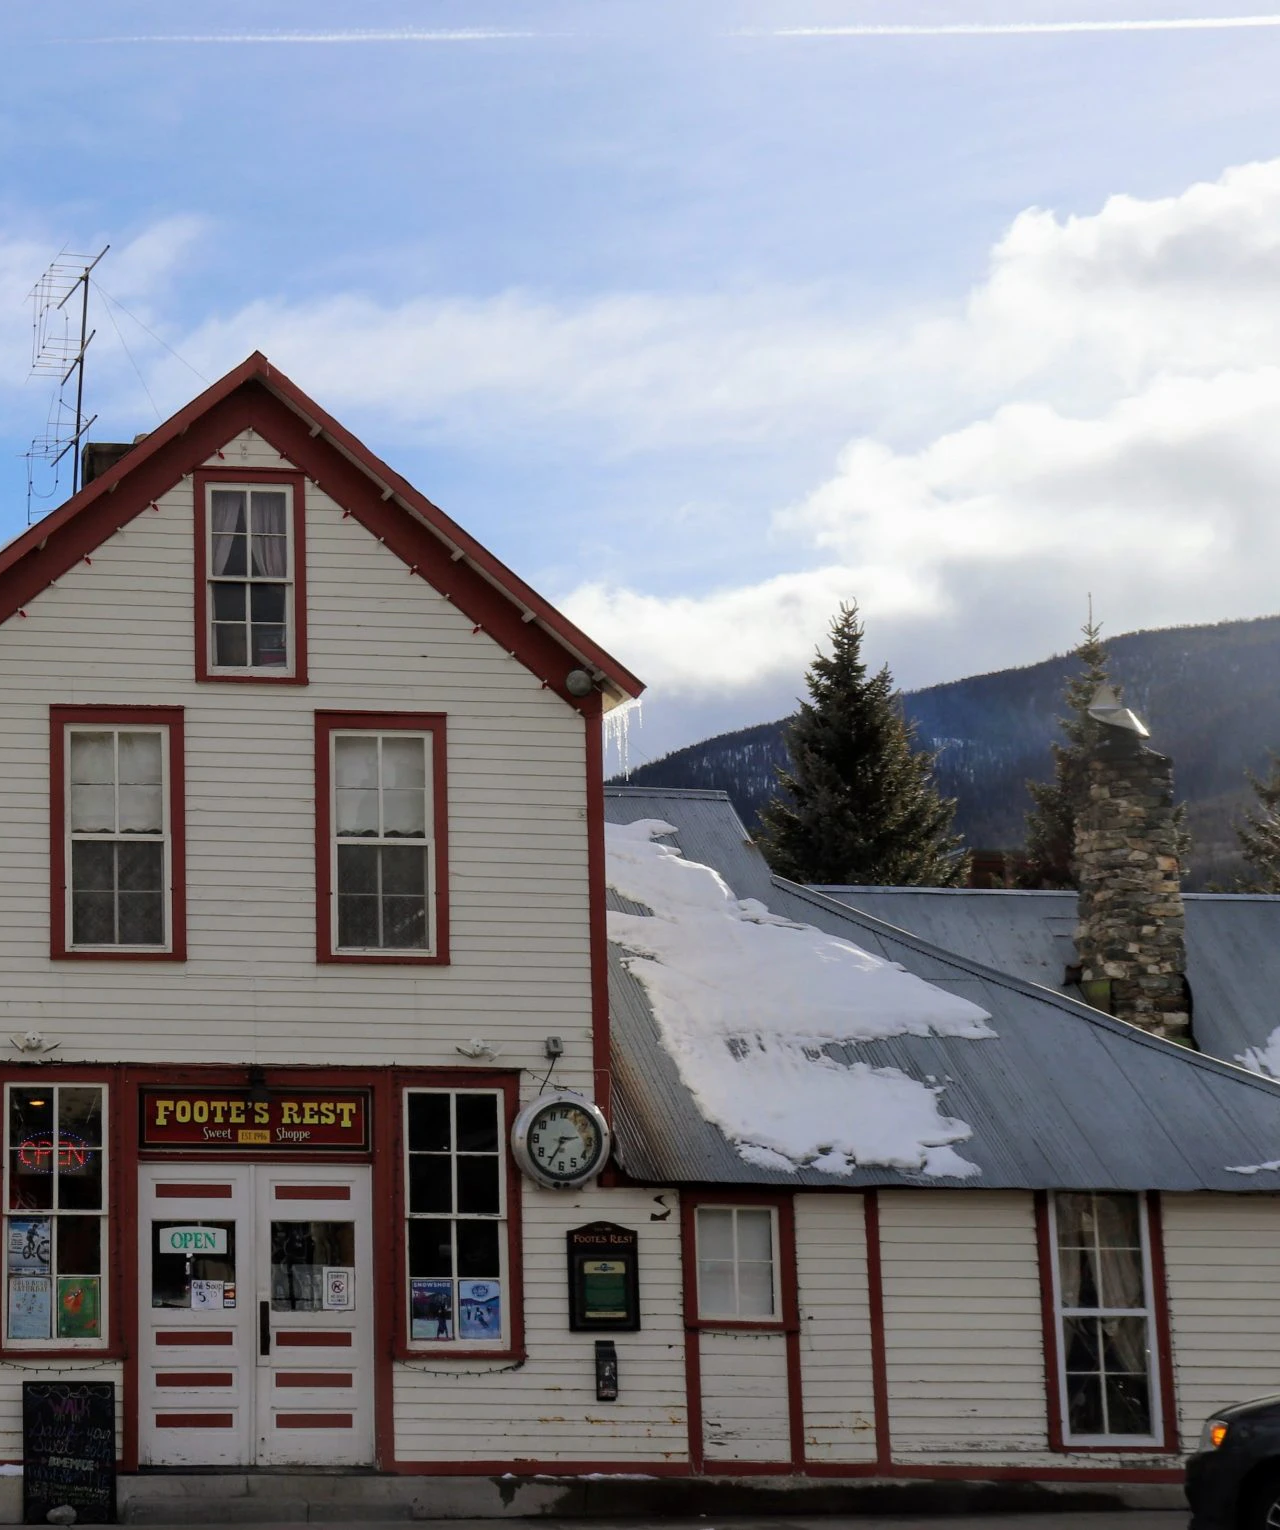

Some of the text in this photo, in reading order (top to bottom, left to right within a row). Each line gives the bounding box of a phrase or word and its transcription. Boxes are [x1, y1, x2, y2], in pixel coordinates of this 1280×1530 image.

[156, 1101, 356, 1127] FOOTE'S REST
[550, 1112, 557, 1121] 11
[539, 1121, 547, 1130] 10
[203, 1127, 312, 1141] Sweet Shoppe
[19, 1141, 86, 1166] OPEN
[538, 1147, 545, 1157] 8
[558, 1161, 565, 1171] 6
[570, 1158, 577, 1168] 5
[171, 1232, 216, 1249] OPEN
[610, 1234, 632, 1244] REST
